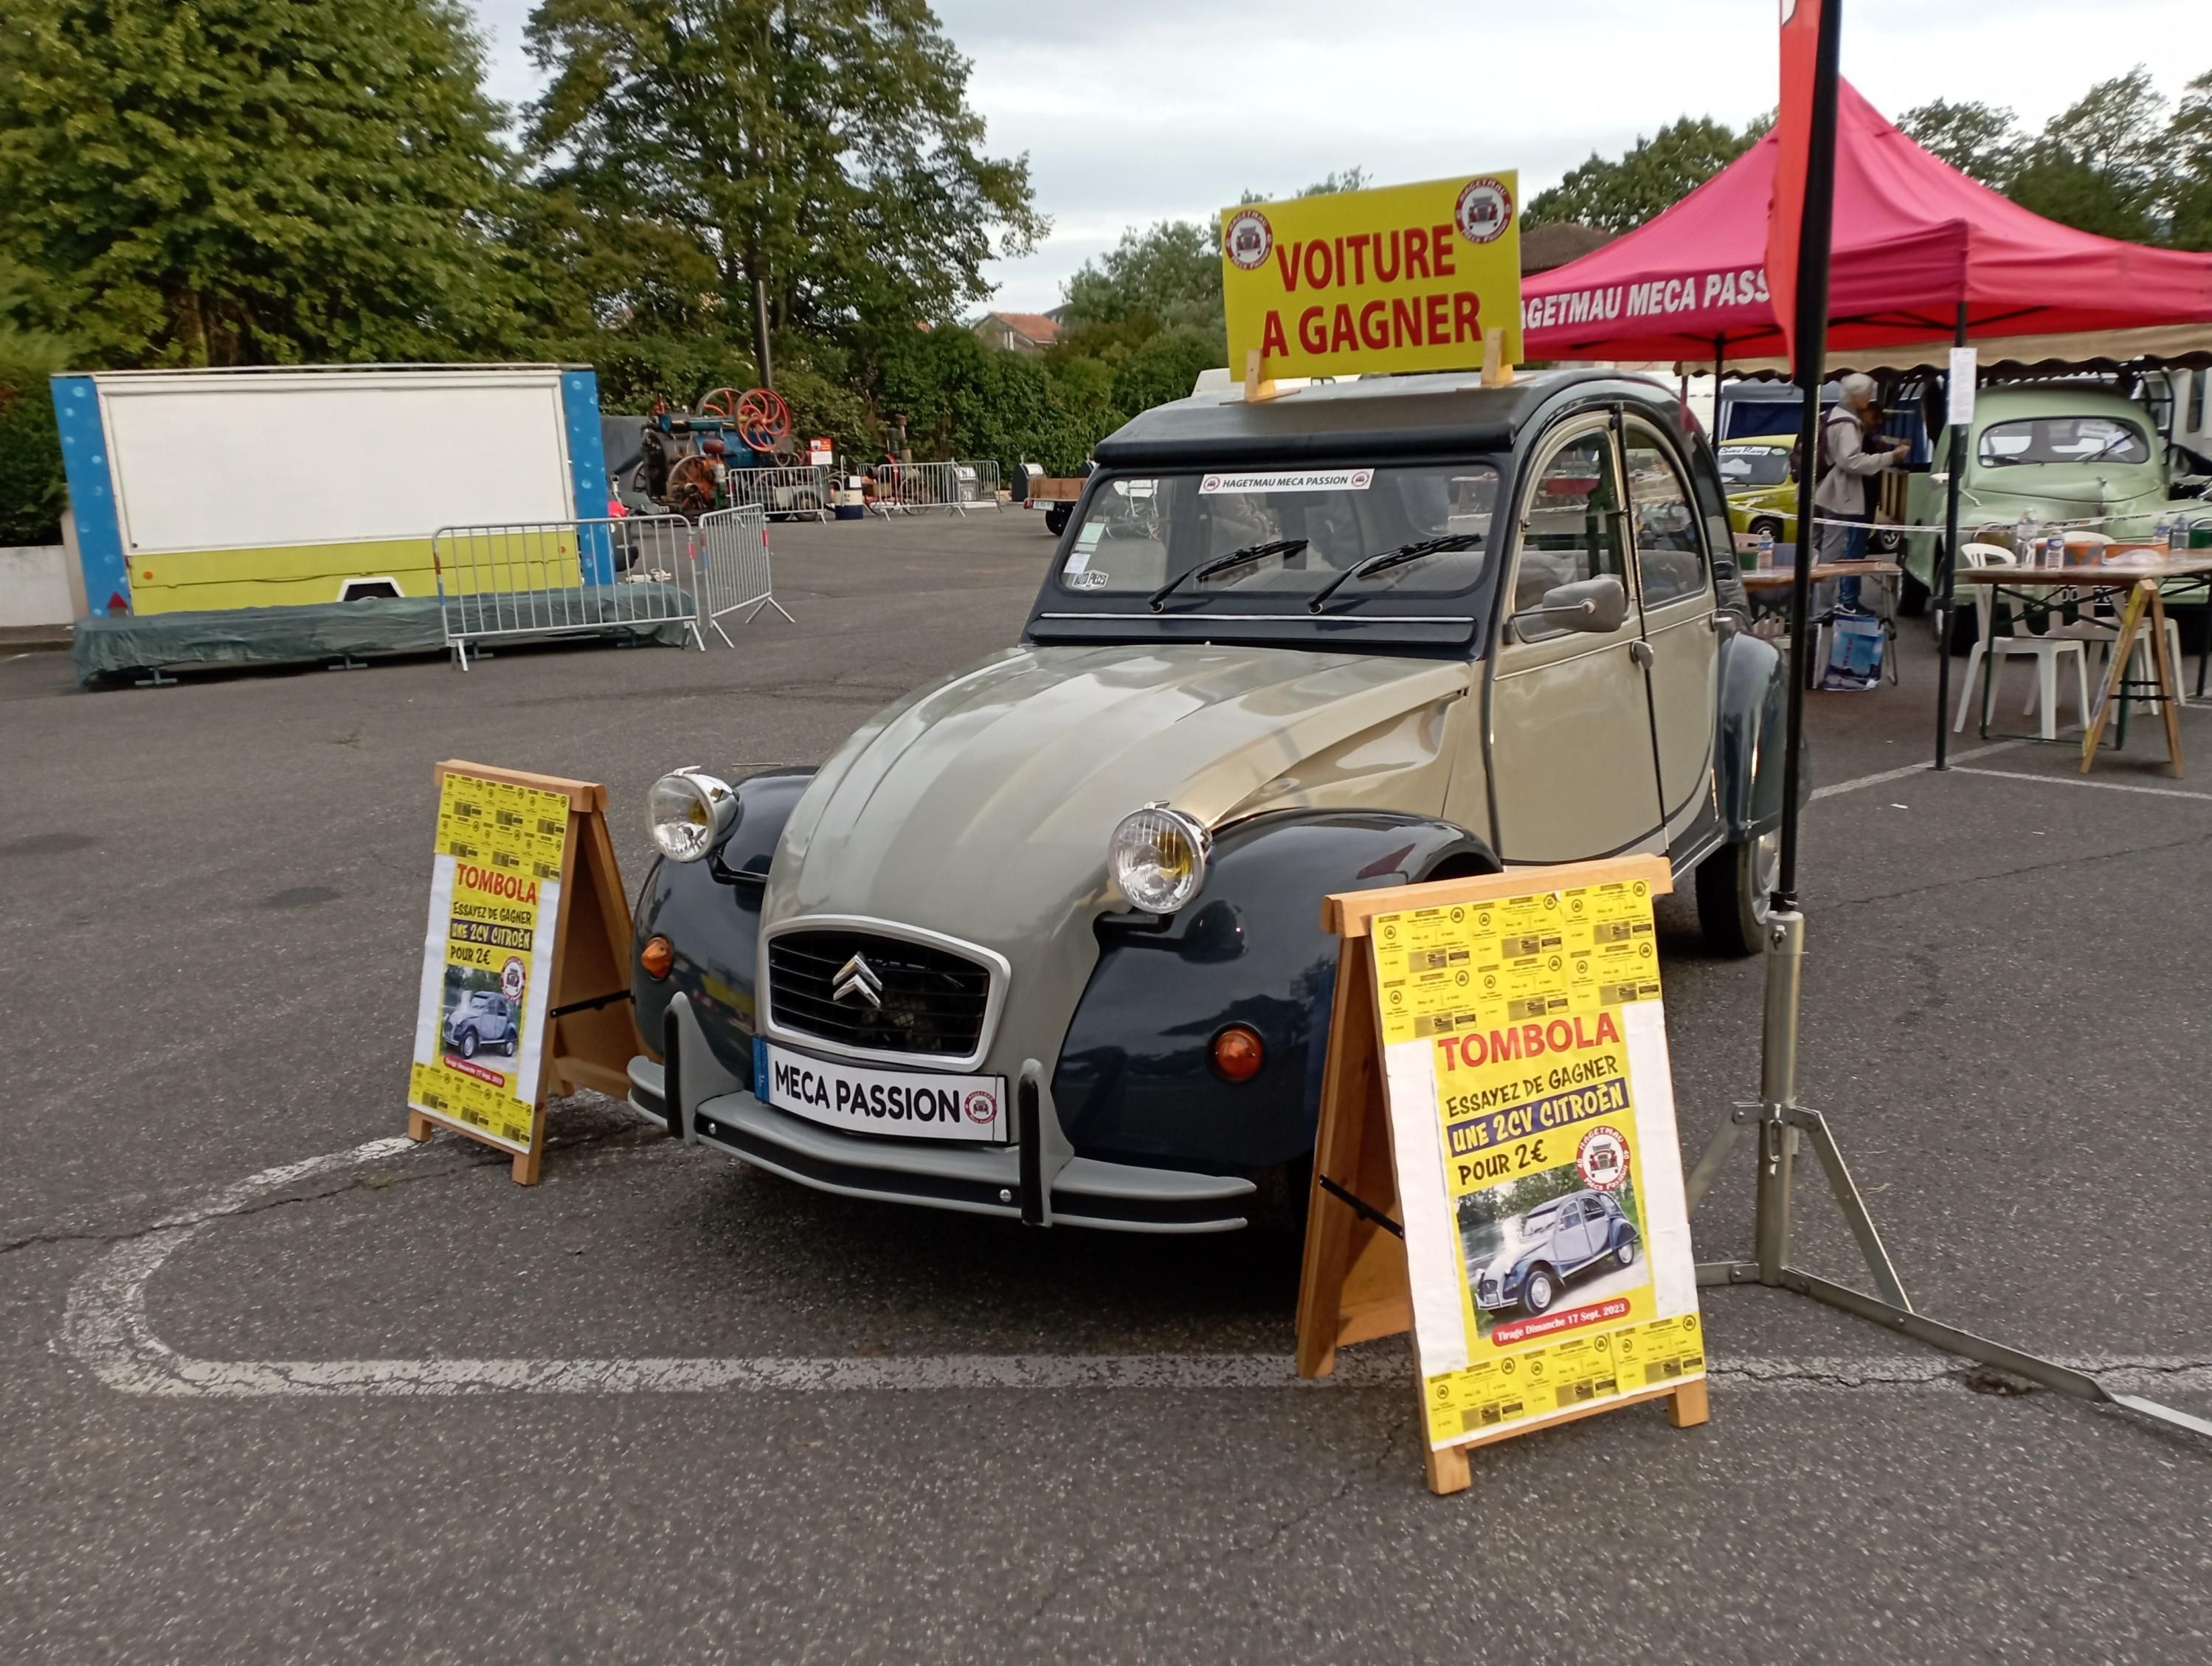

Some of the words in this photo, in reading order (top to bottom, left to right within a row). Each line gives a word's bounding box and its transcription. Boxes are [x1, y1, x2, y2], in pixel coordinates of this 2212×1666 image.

[1276, 224, 1456, 292] VOITURE
[1626, 277, 1696, 316] MECA
[1262, 310, 1289, 358] A
[1299, 291, 1482, 355] GAGNER
[1223, 478, 1276, 488] HAGETMAU
[1276, 477, 1304, 486] MECA
[1305, 476, 1348, 485] PASSION
[457, 863, 536, 905] TOMBOLA
[453, 902, 486, 919] ESSAYEZ
[488, 908, 498, 920] DE
[500, 908, 532, 926] GAGNER
[450, 945, 474, 962] POUR
[476, 947, 491, 965] 2€
[452, 922, 469, 939] UNE
[470, 924, 489, 942] 2CV
[491, 928, 530, 949] CITROËN
[1438, 1012, 1620, 1071] TOMBOLA
[775, 1060, 831, 1109] MECA
[835, 1079, 961, 1123] PASSION
[1446, 1082, 1518, 1118] ESSAYEZ
[1523, 1076, 1544, 1098] DE
[1549, 1055, 1618, 1090] GAGNER
[1452, 1124, 1490, 1152] UNE
[1493, 1106, 1532, 1141] 2CV
[1539, 1082, 1623, 1127] CITROËN
[1578, 1127, 1624, 1150] HAGETMAU
[1458, 1153, 1510, 1186] POUR
[1515, 1139, 1548, 1169] 2€
[1497, 1329, 1524, 1341] Tirage
[1525, 1318, 1566, 1335] Dimanche
[1567, 1314, 1579, 1324] 17
[1580, 1311, 1601, 1322] Sept.
[1603, 1303, 1625, 1316] 2023
